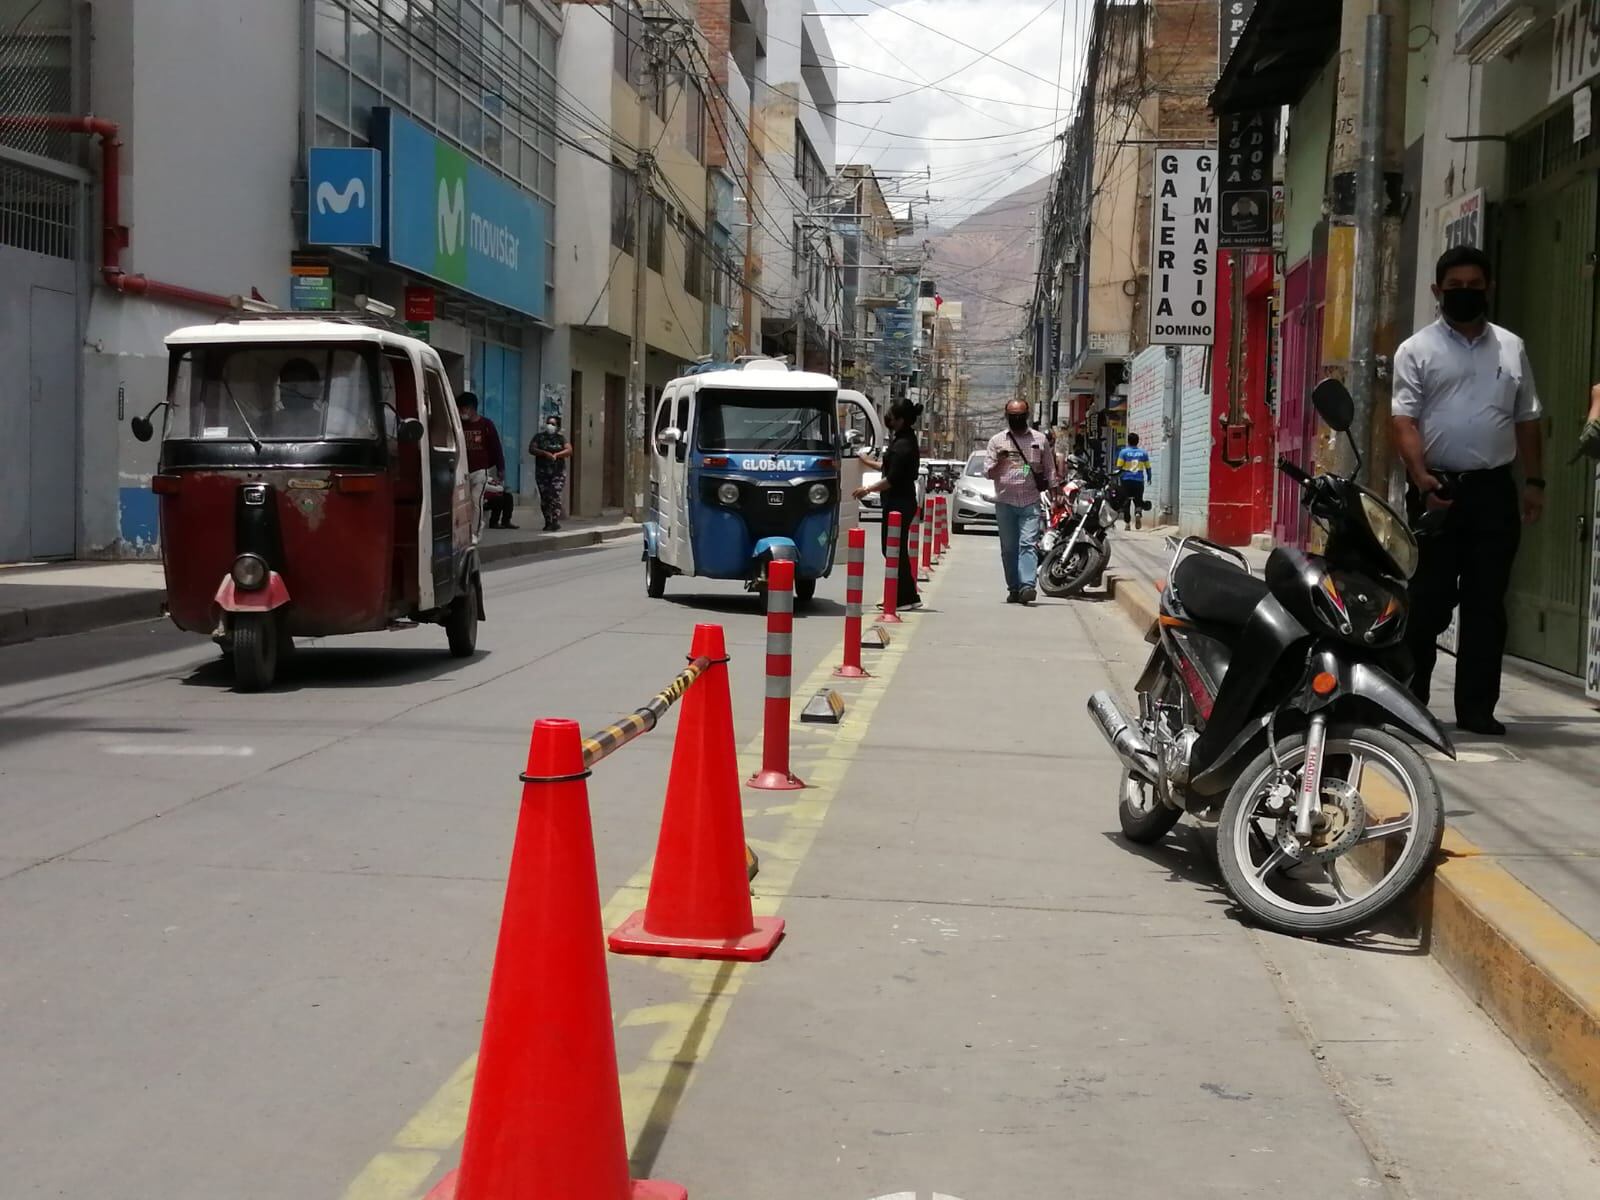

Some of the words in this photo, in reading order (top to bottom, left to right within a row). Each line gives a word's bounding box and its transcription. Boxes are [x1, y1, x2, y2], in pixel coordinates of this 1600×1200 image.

[470, 211, 520, 272] movistar
[1156, 155, 1179, 317] GALERIA
[1191, 155, 1212, 317] GIMNASIO
[1155, 324, 1212, 337] DOMINO
